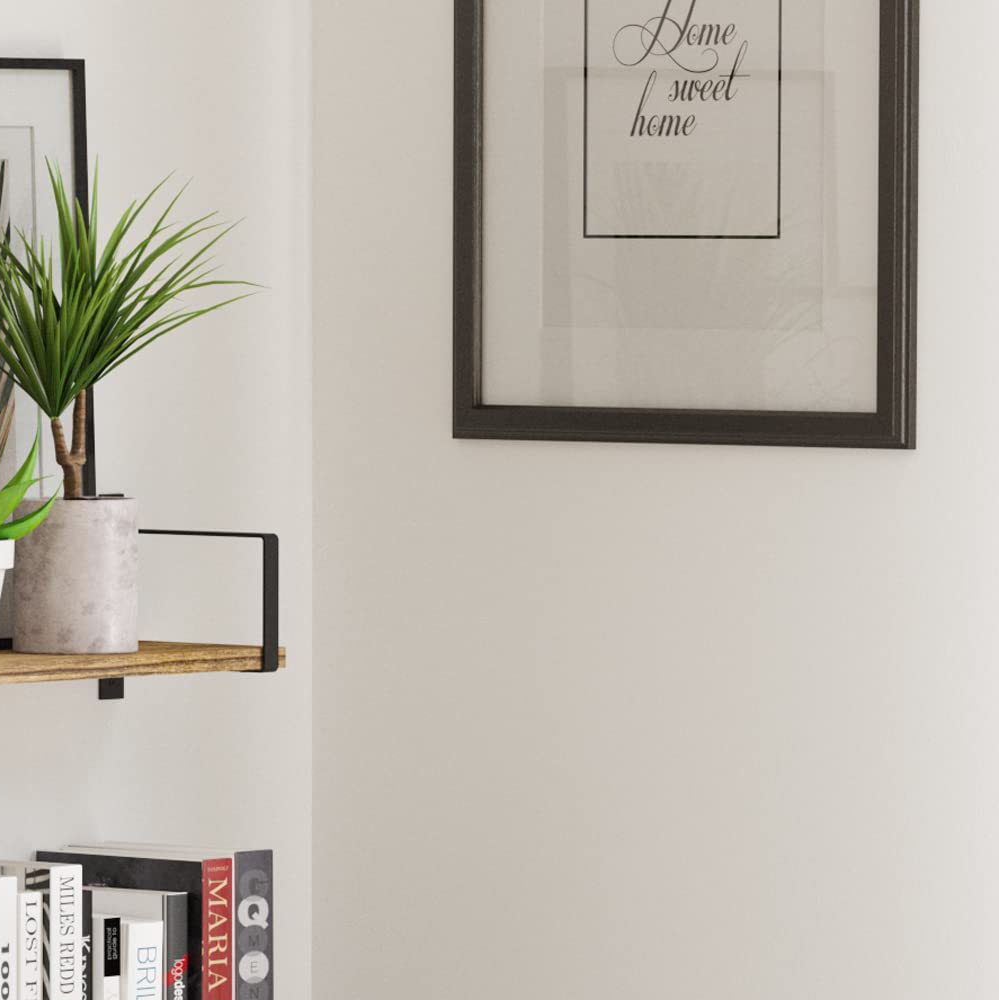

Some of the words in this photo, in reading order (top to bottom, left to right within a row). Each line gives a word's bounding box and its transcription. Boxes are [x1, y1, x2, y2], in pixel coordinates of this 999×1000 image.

[668, 40, 750, 102] sweet
[630, 70, 698, 137] home
[25, 901, 37, 971] LOST
[59, 877, 74, 936] MILES
[208, 876, 228, 992] MARIA
[1, 943, 10, 1000] 100
[59, 942, 74, 994] REDD
